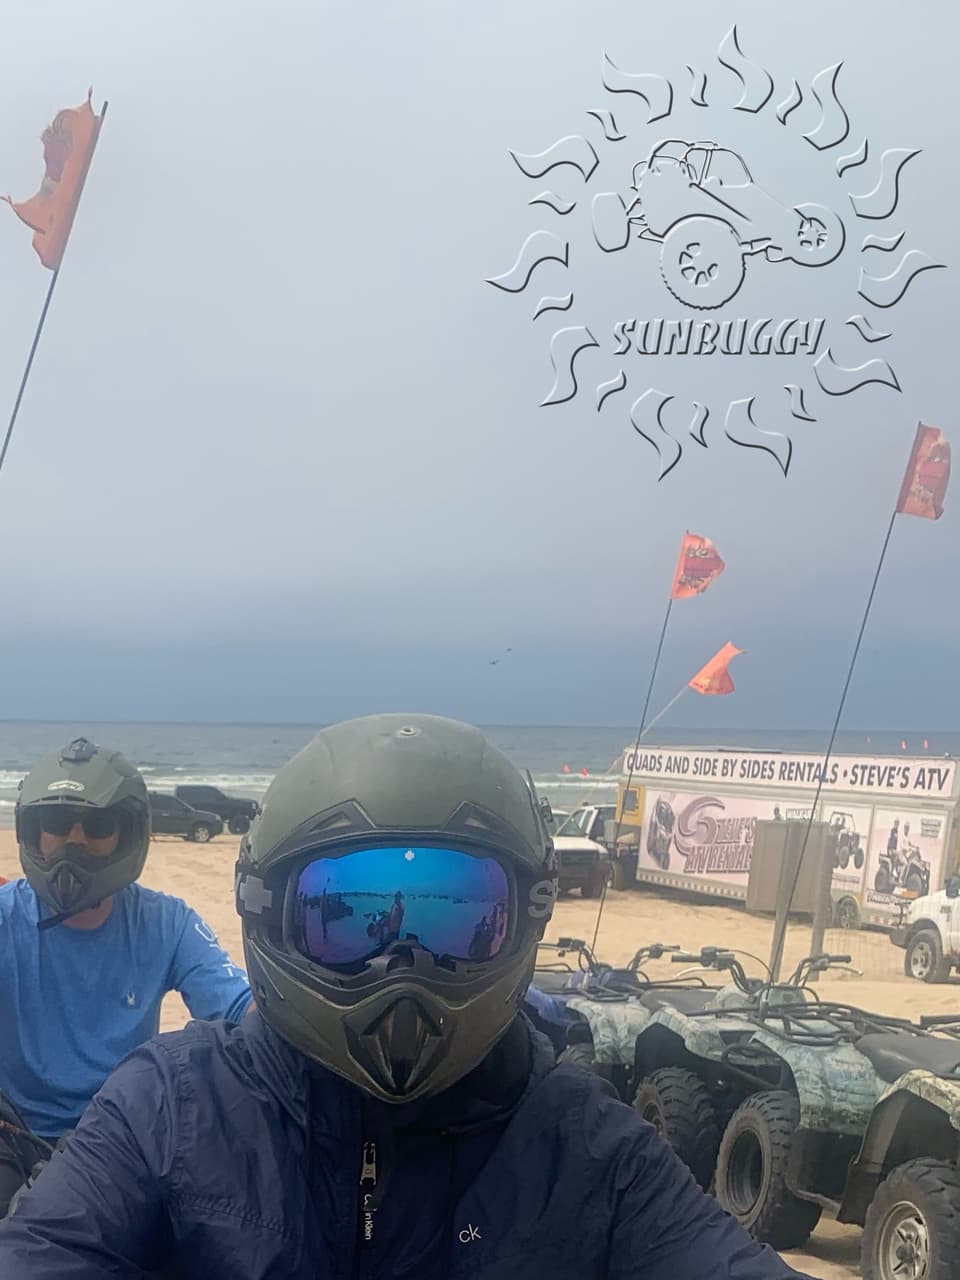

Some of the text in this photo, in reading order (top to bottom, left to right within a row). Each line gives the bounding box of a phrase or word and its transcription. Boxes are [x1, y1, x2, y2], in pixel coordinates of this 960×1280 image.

[627, 753, 951, 791] QUADS AND SIDE BY SIDES RENTALS STEVE'S ATV
[706, 844, 753, 874] RENTAL
